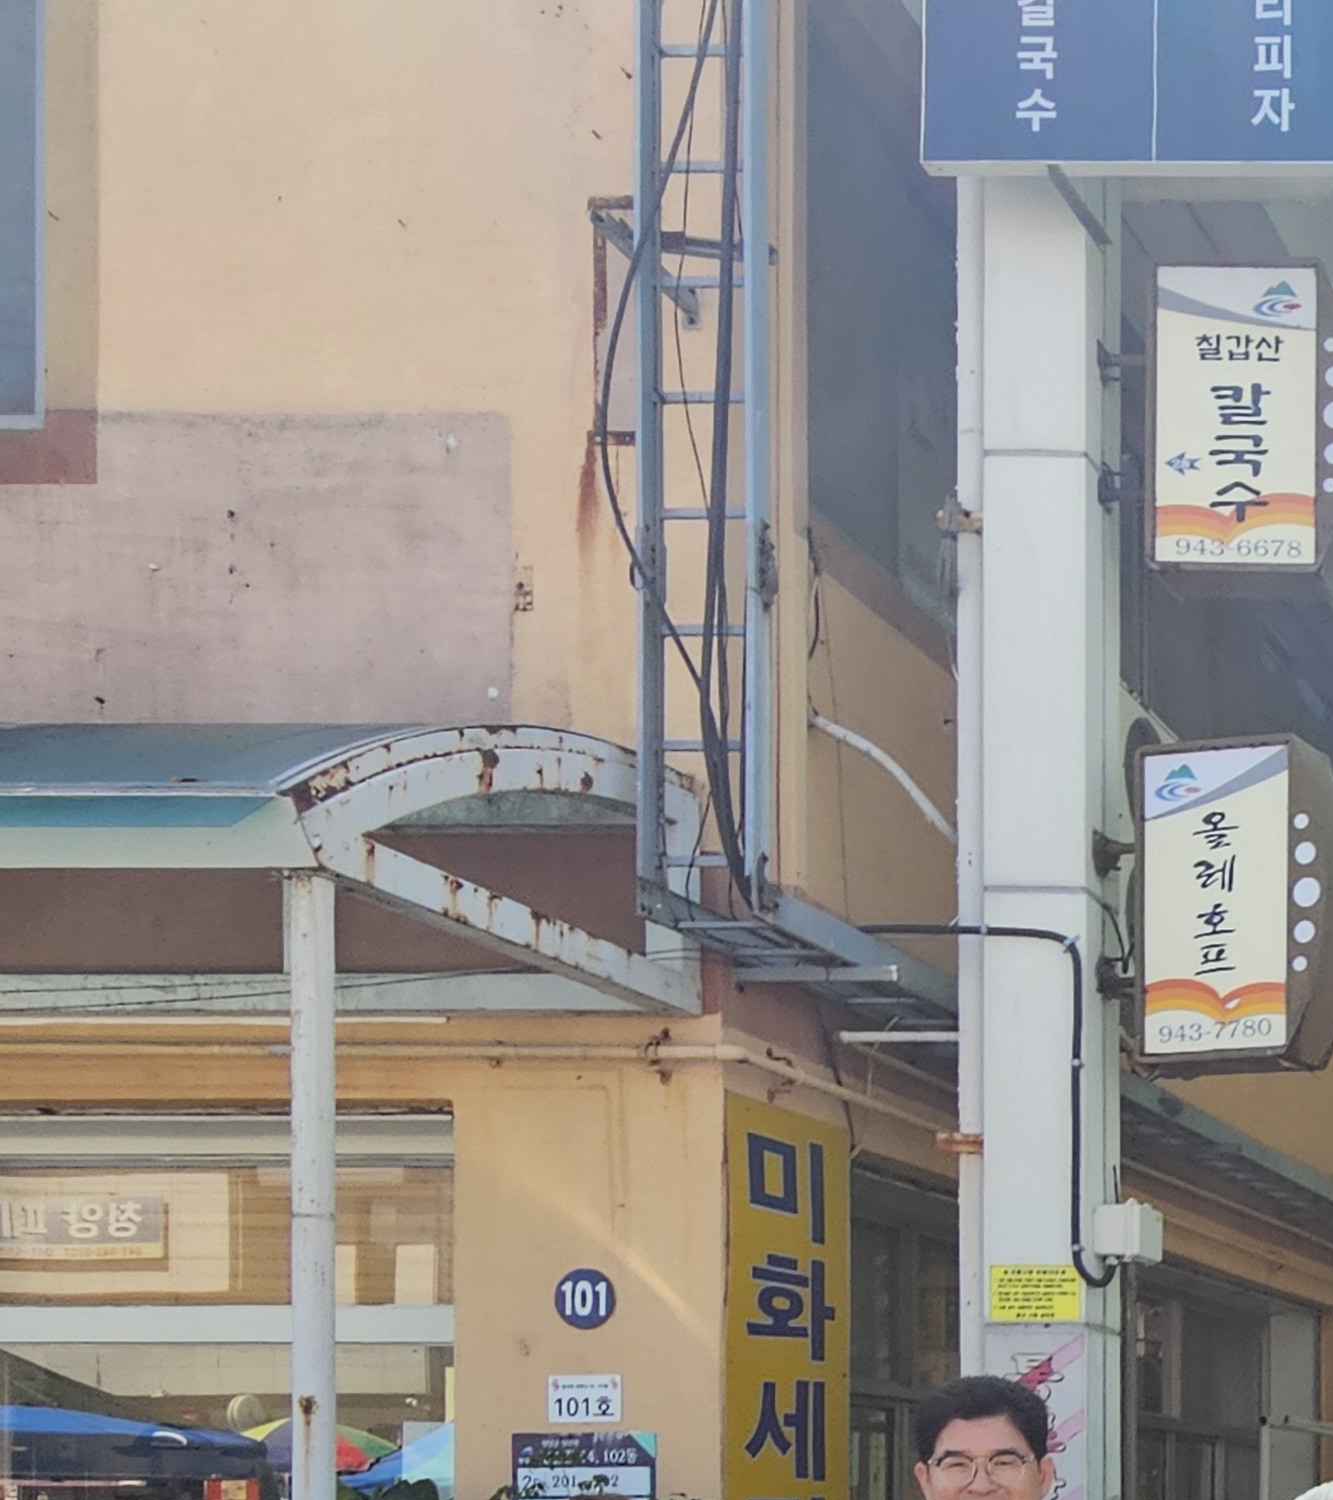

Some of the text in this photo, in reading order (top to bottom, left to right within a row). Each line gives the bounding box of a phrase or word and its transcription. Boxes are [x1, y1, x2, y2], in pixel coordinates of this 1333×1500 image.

[1195, 334, 1284, 361] 칠갑산
[1209, 383, 1271, 522] 칼국수
[1175, 537, 1302, 559] 943-6678
[1192, 811, 1240, 976] 올레호프
[1158, 1017, 1272, 1043] 943-7780
[560, 1281, 607, 1317] 101
[554, 1396, 614, 1417] 101호
